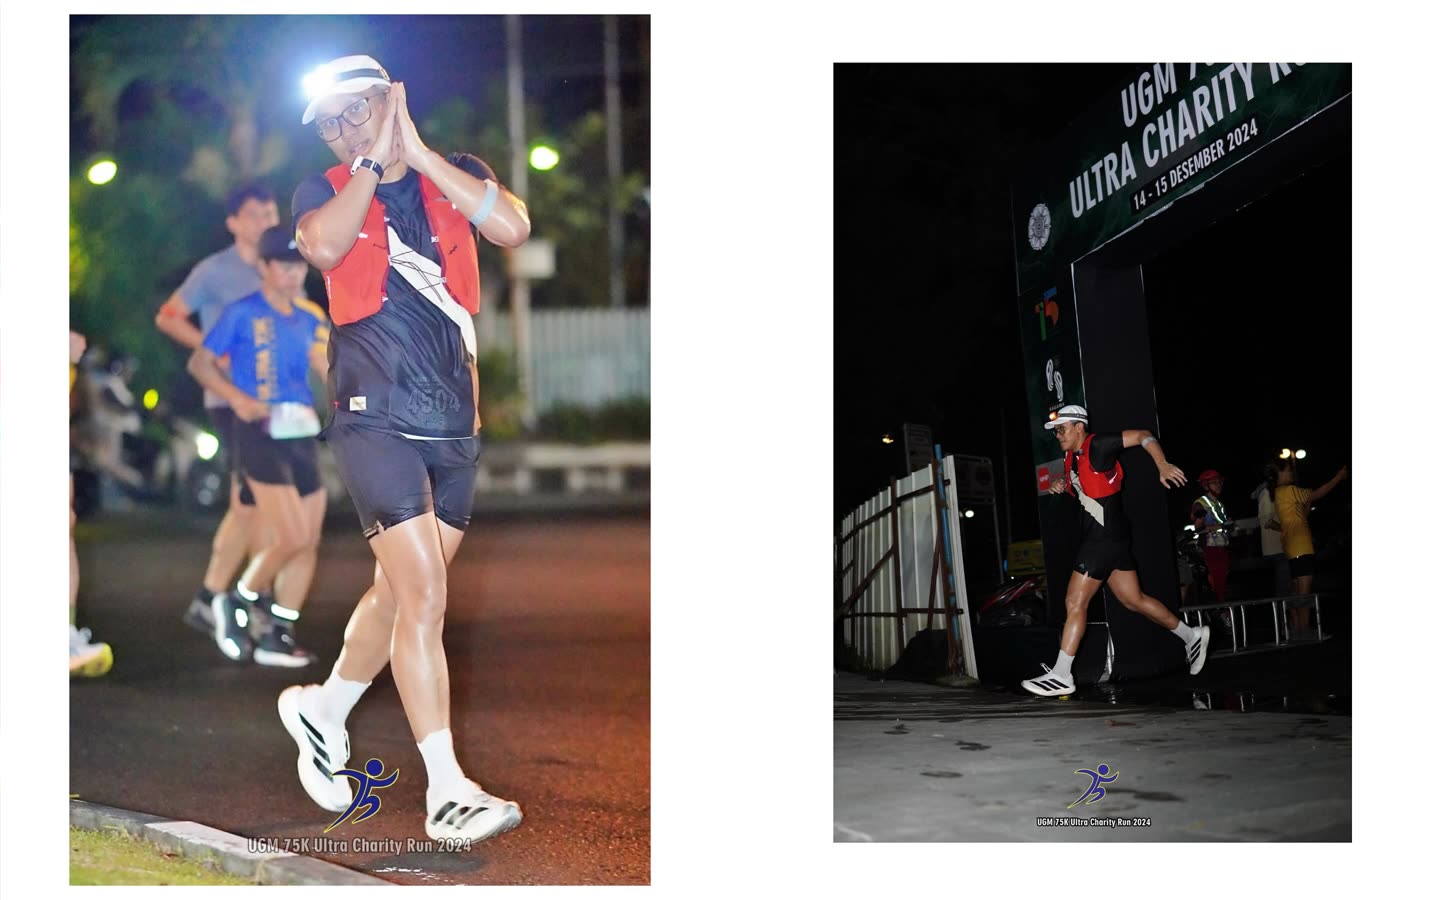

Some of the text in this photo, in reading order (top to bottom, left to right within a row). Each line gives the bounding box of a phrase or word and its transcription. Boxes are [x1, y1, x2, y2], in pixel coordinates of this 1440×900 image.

[1069, 63, 1256, 219] ULTRA CHARITY
[1121, 63, 1177, 128] UGM
[1133, 190, 1147, 210] 14
[1155, 175, 1168, 197] 15
[1169, 142, 1225, 187] DESEMBER
[1226, 118, 1258, 152] 2024
